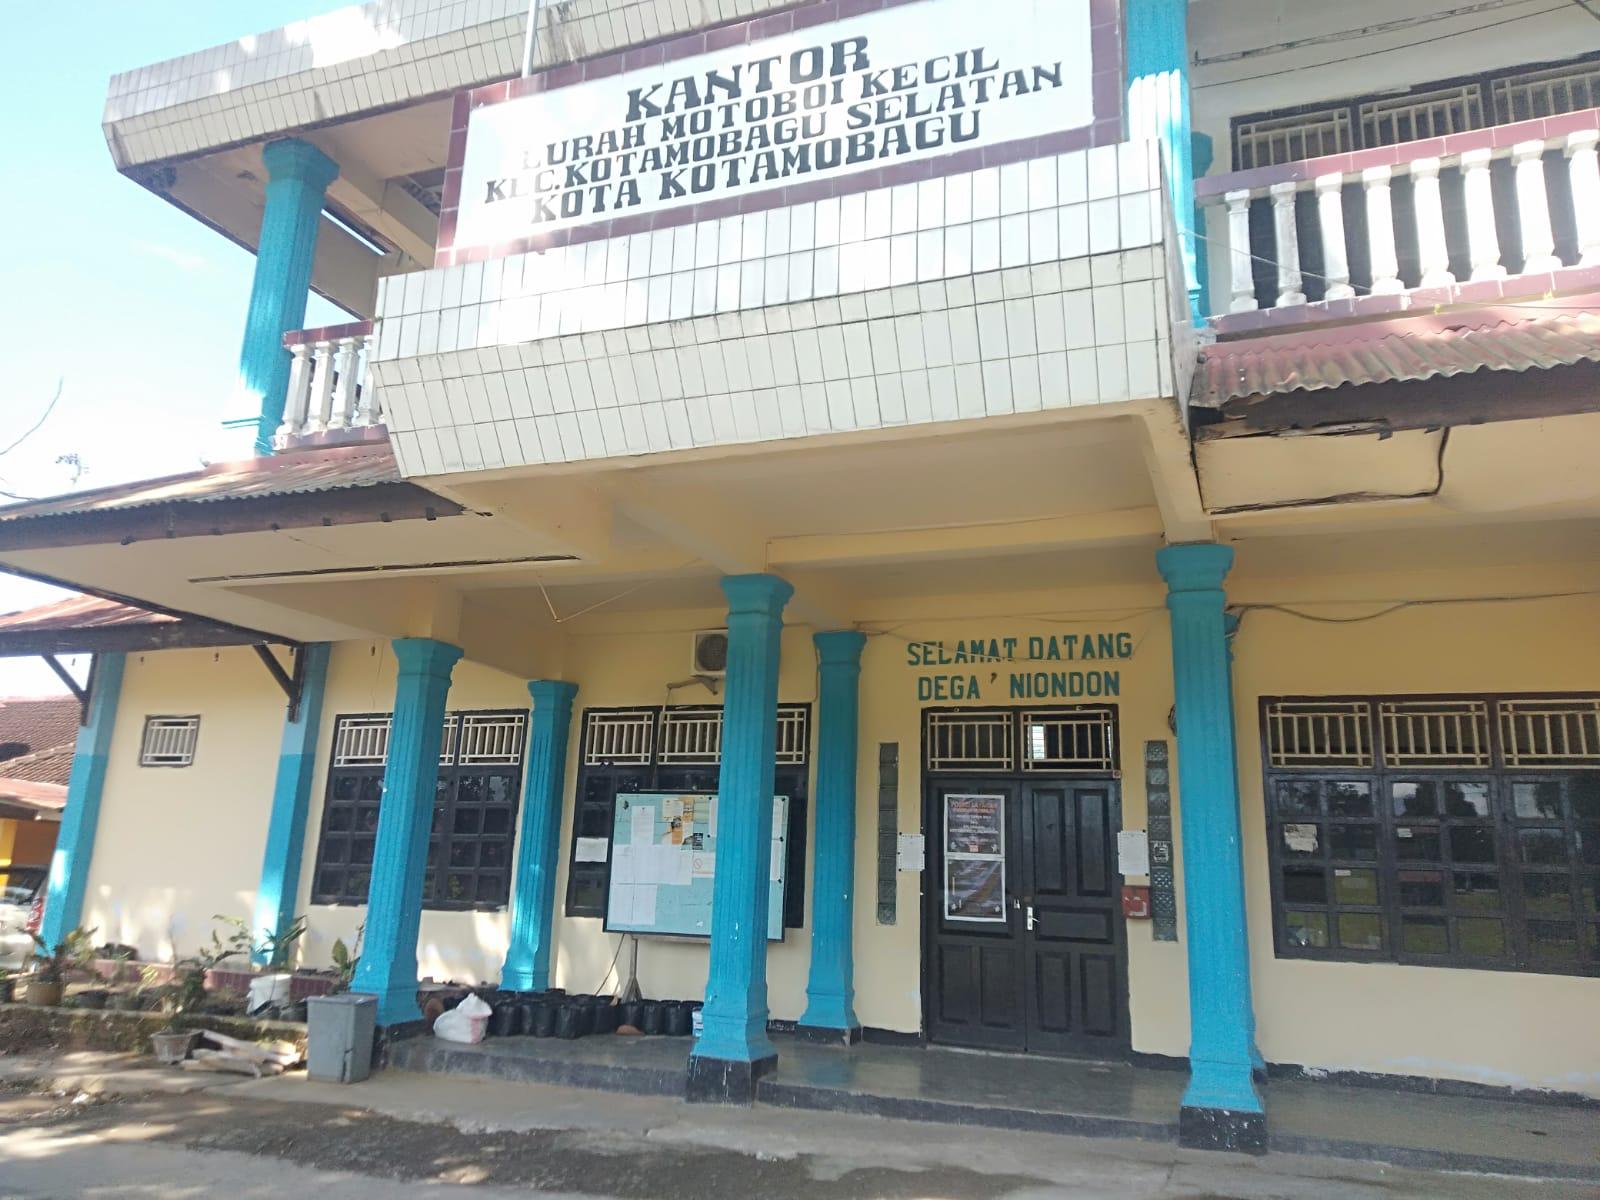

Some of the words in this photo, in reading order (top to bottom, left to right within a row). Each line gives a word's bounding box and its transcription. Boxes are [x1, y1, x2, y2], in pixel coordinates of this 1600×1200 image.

[522, 123, 646, 170] LURAH
[660, 79, 844, 142] MOTOBOI
[860, 47, 1000, 99] KECIL
[625, 35, 870, 122] KANTOR
[847, 61, 1063, 130] SELATAN
[531, 179, 642, 224] KOTA
[659, 108, 981, 200] KOTAMOBAGU
[907, 638, 1018, 666] SELAMAT
[1029, 632, 1133, 661] DATANG
[1010, 670, 1120, 699] NIONDON
